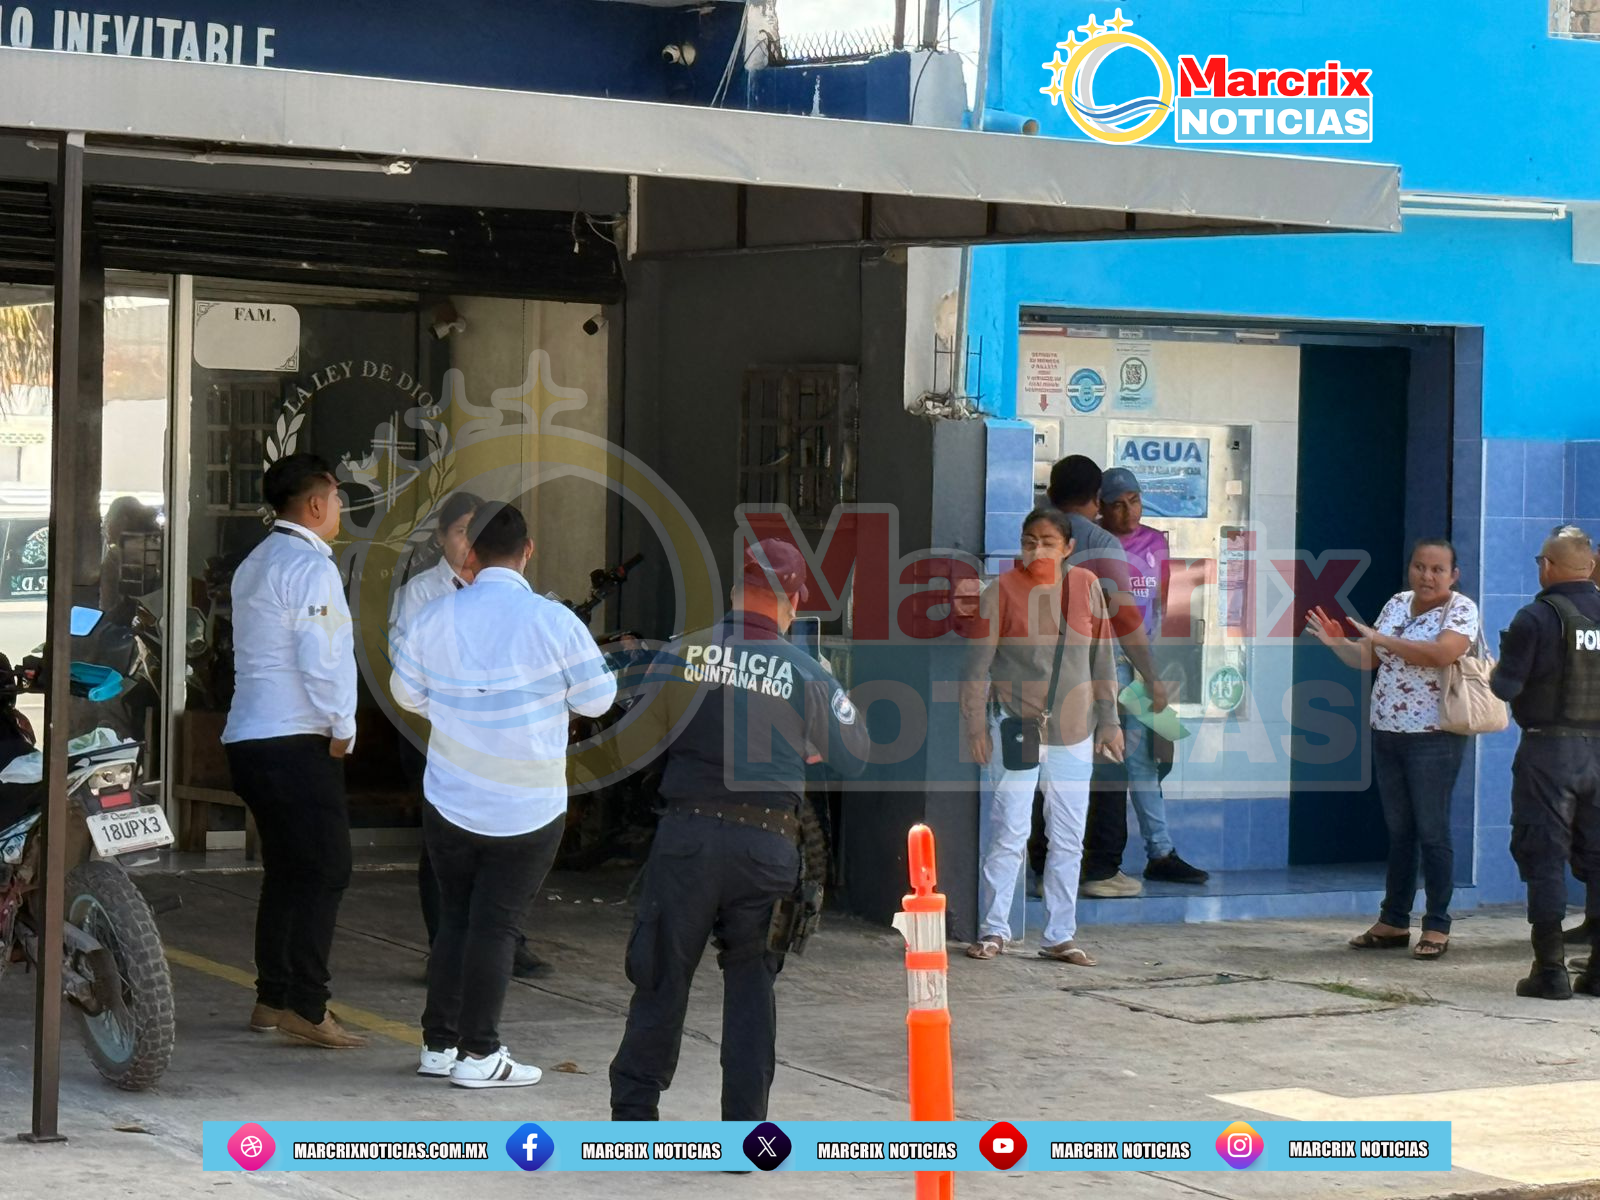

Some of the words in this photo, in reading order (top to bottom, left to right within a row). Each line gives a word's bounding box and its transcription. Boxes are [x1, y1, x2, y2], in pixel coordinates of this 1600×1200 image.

[0, 5, 34, 49] O
[233, 307, 276, 321] FAM.
[311, 360, 353, 391] LEY
[360, 360, 393, 382] DE
[396, 371, 442, 420] DIOS
[1120, 440, 1203, 463] AGUA
[684, 664, 759, 693] QUINTANA
[761, 676, 793, 700] ROO
[686, 645, 793, 685] POLICÍA
[101, 816, 161, 842] 18UPX3
